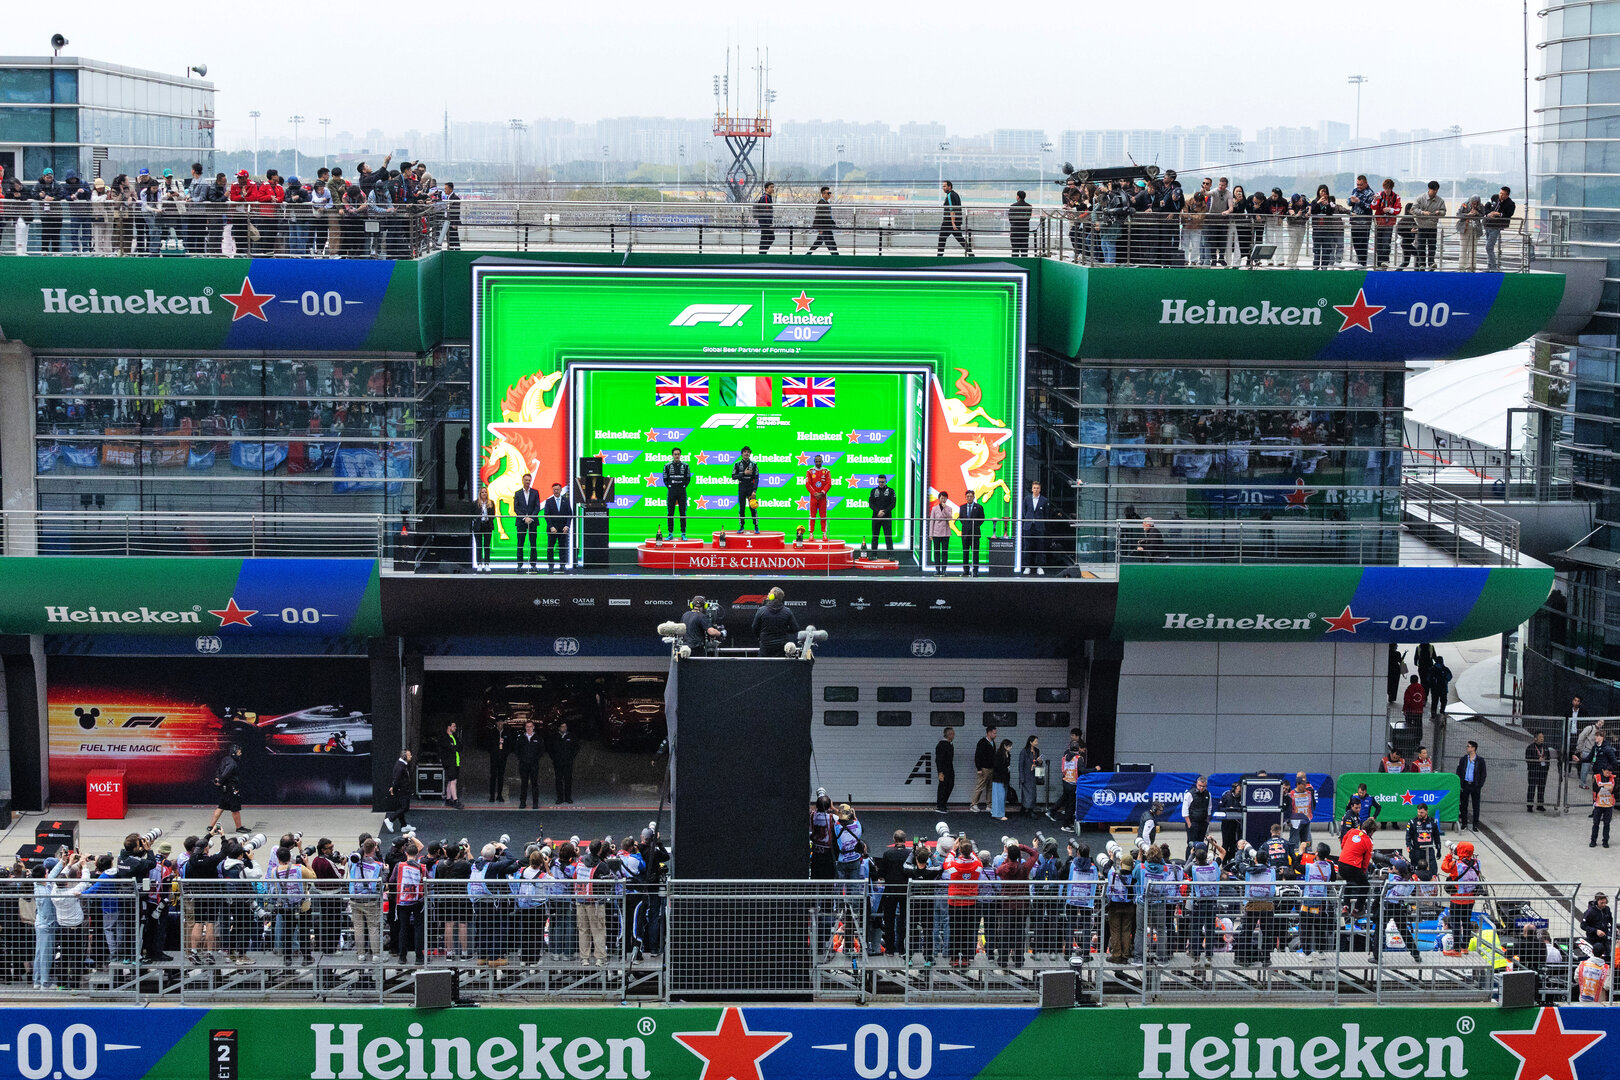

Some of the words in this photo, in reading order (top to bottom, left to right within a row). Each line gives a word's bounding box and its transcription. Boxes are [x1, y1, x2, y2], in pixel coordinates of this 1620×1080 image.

[746, 539, 753, 548] 1
[689, 554, 726, 568] MOËT
[729, 557, 739, 568] &
[742, 556, 806, 568] CHANDON
[820, 598, 837, 606] aws
[196, 637, 221, 652] FIA
[554, 638, 579, 654] FIA
[911, 640, 936, 656] FIA
[80, 743, 105, 752] FUEL
[107, 744, 127, 752] THE
[129, 744, 162, 752] MAGIC
[904, 752, 932, 785] A
[89, 781, 121, 793] MOËT
[1093, 790, 1115, 805] FIA
[1118, 791, 1150, 803] PARC
[1253, 789, 1273, 802] FIA
[1423, 793, 1435, 803] 0.0
[217, 1045, 231, 1062] 2
